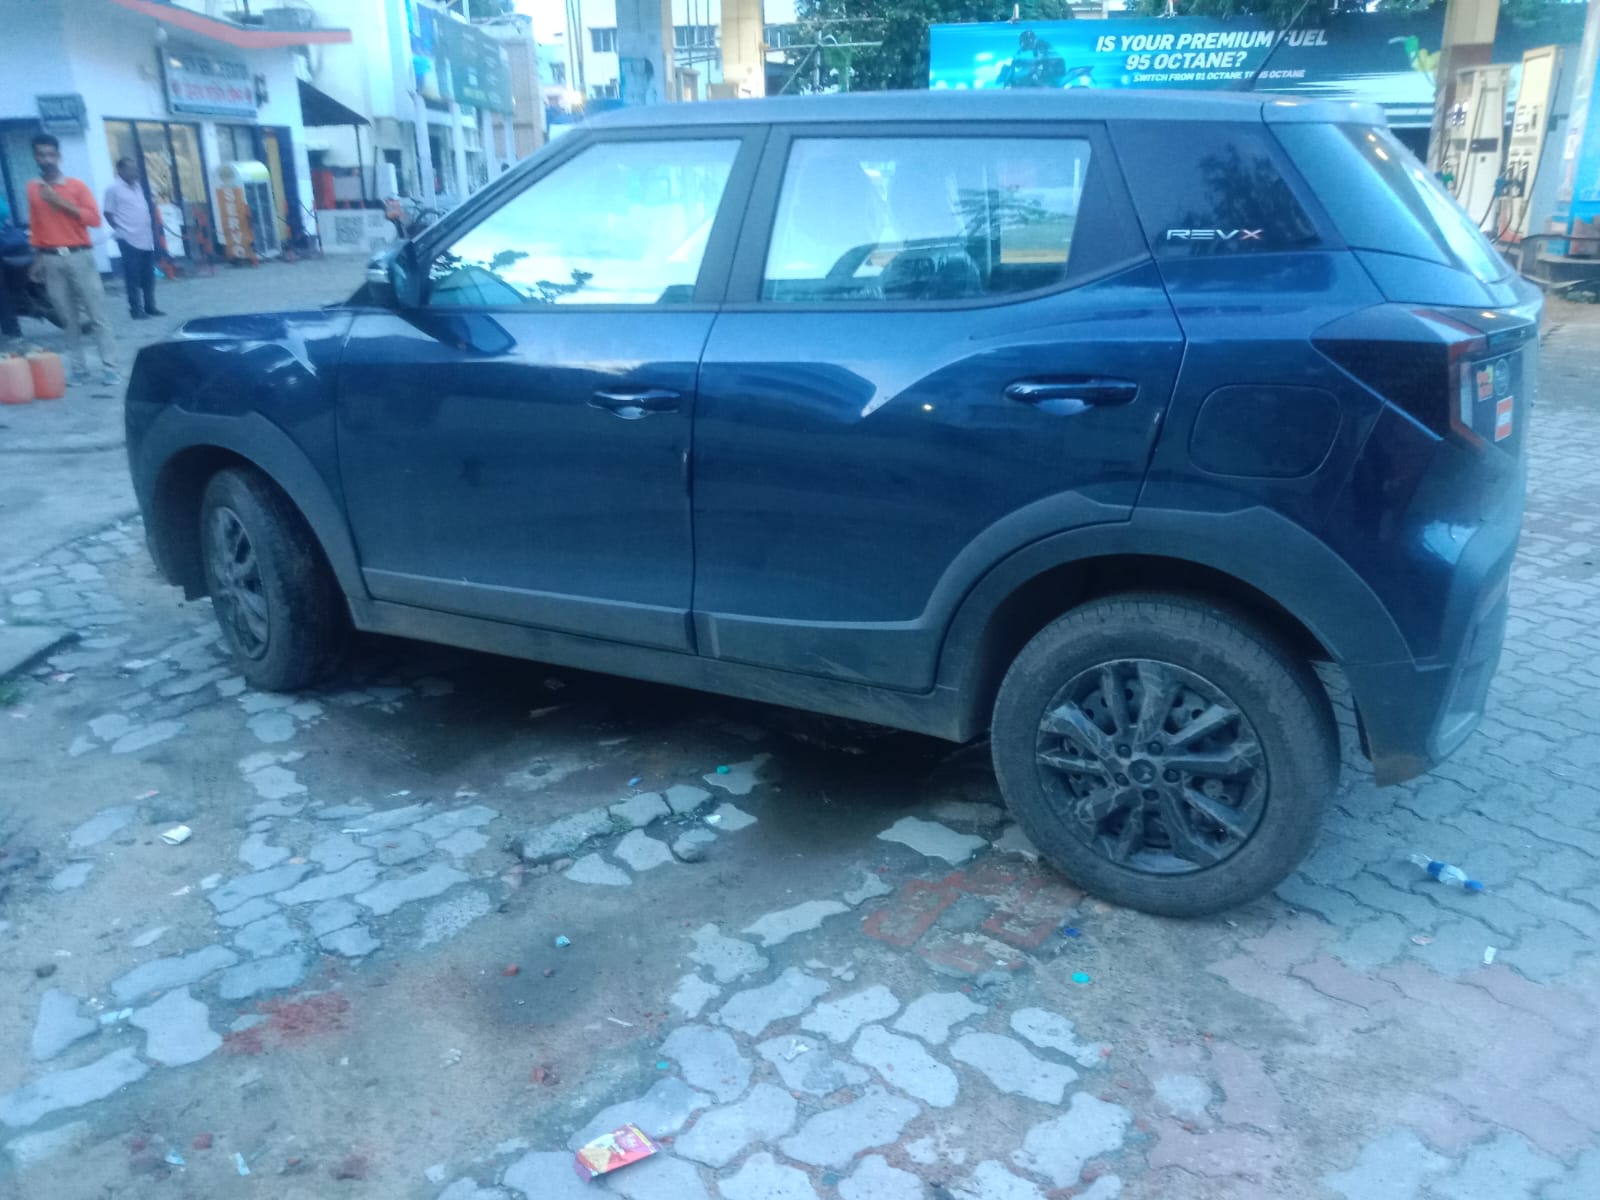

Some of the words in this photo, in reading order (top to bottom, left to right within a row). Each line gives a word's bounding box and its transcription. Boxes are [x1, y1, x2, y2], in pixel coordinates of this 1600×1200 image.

[1096, 36, 1117, 53] IS
[1121, 34, 1175, 52] YOUR
[1176, 30, 1275, 50] PREMIUM
[1126, 54, 1154, 70] 95
[1154, 51, 1248, 70] OCTANE?
[1133, 73, 1169, 82] SWITCH
[1168, 72, 1195, 82] FROM
[1206, 71, 1243, 80] OCTANE
[1269, 69, 1306, 78] OCTANE
[1166, 228, 1263, 241] REVX
